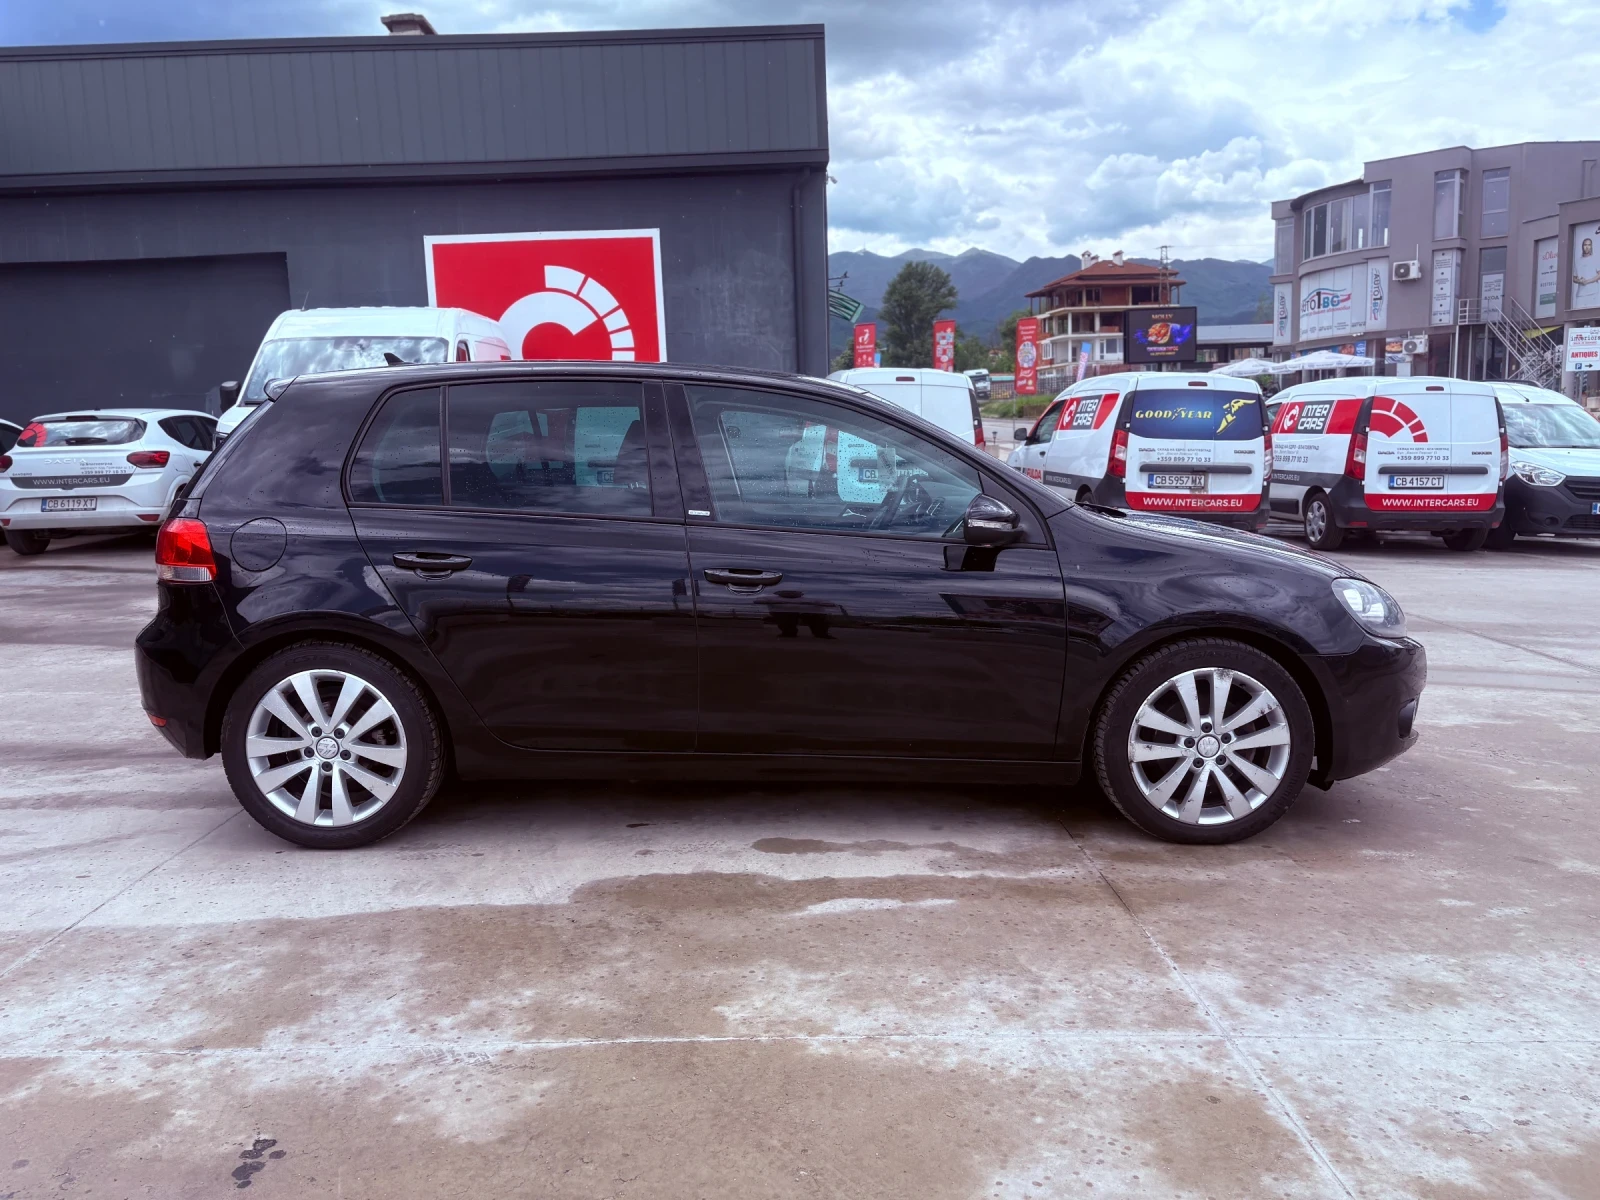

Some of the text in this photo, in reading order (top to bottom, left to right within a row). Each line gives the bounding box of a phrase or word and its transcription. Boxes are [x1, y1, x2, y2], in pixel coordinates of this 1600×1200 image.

[1571, 351, 1598, 359] ANTIQUES
[1077, 399, 1099, 413] INTER
[1302, 404, 1330, 417] INTER
[1072, 413, 1094, 426] CARS
[1298, 418, 1325, 430] CARS
[33, 477, 110, 486] WWW.INTERCARS.EU
[1154, 476, 1167, 485] CB
[1168, 476, 1190, 486] 5957
[1396, 477, 1442, 486] CB 4157 CT
[47, 498, 95, 509] CB 6119 XT
[1143, 497, 1243, 508] WWW.INTERCARS.EU
[1382, 498, 1479, 507] WWW.INTERCARS.EU
